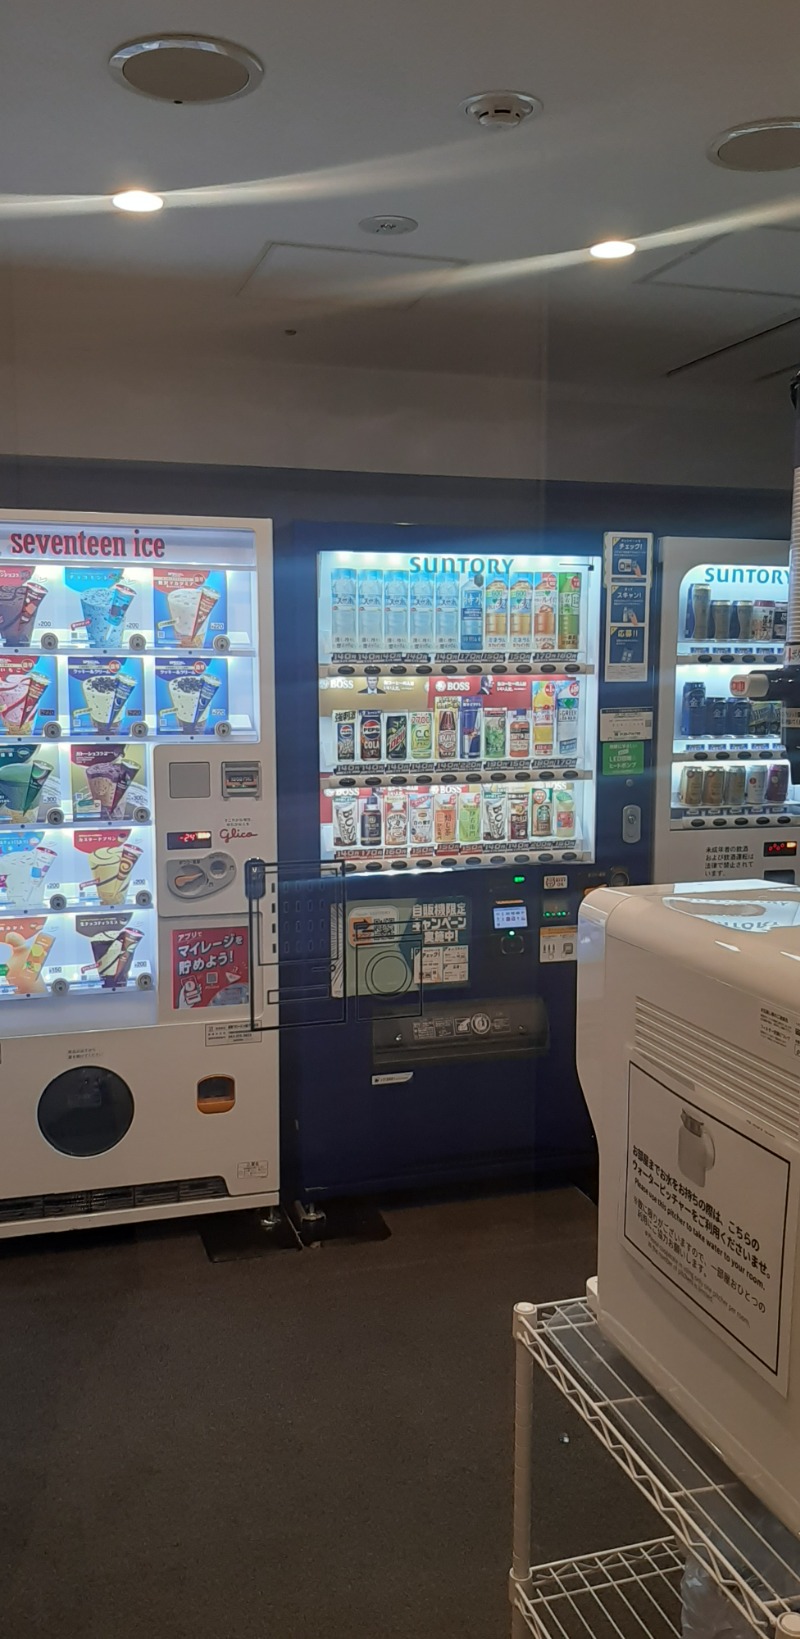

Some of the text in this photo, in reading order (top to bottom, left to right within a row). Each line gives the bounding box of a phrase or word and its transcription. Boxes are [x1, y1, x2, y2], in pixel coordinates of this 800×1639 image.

[10, 529, 165, 557] seventeen ice
[409, 557, 515, 575] SUNTORY
[330, 679, 354, 689] BOSS
[447, 681, 470, 691] BOSS
[342, 808, 355, 842] BOSS
[492, 804, 505, 837] BOSS
[219, 828, 258, 843] Glico
[412, 903, 467, 918] 自販機限定
[412, 918, 467, 931] キャンペーン
[178, 931, 202, 942] アプリで
[178, 933, 243, 957] マイレージを
[424, 930, 459, 944] 実施中!
[178, 951, 234, 975] 貯めよう!
[632, 1158, 771, 1283] ウォーターピッチャーをご利用くださいませ。
[634, 1176, 648, 1195] Please
[657, 1197, 666, 1212] this
[666, 1205, 685, 1229] pitcher
[685, 1221, 692, 1233] to
[692, 1225, 705, 1243] take
[705, 1237, 723, 1257] water
[722, 1250, 730, 1263] to
[730, 1257, 745, 1277] your
[746, 1269, 765, 1292] room.
